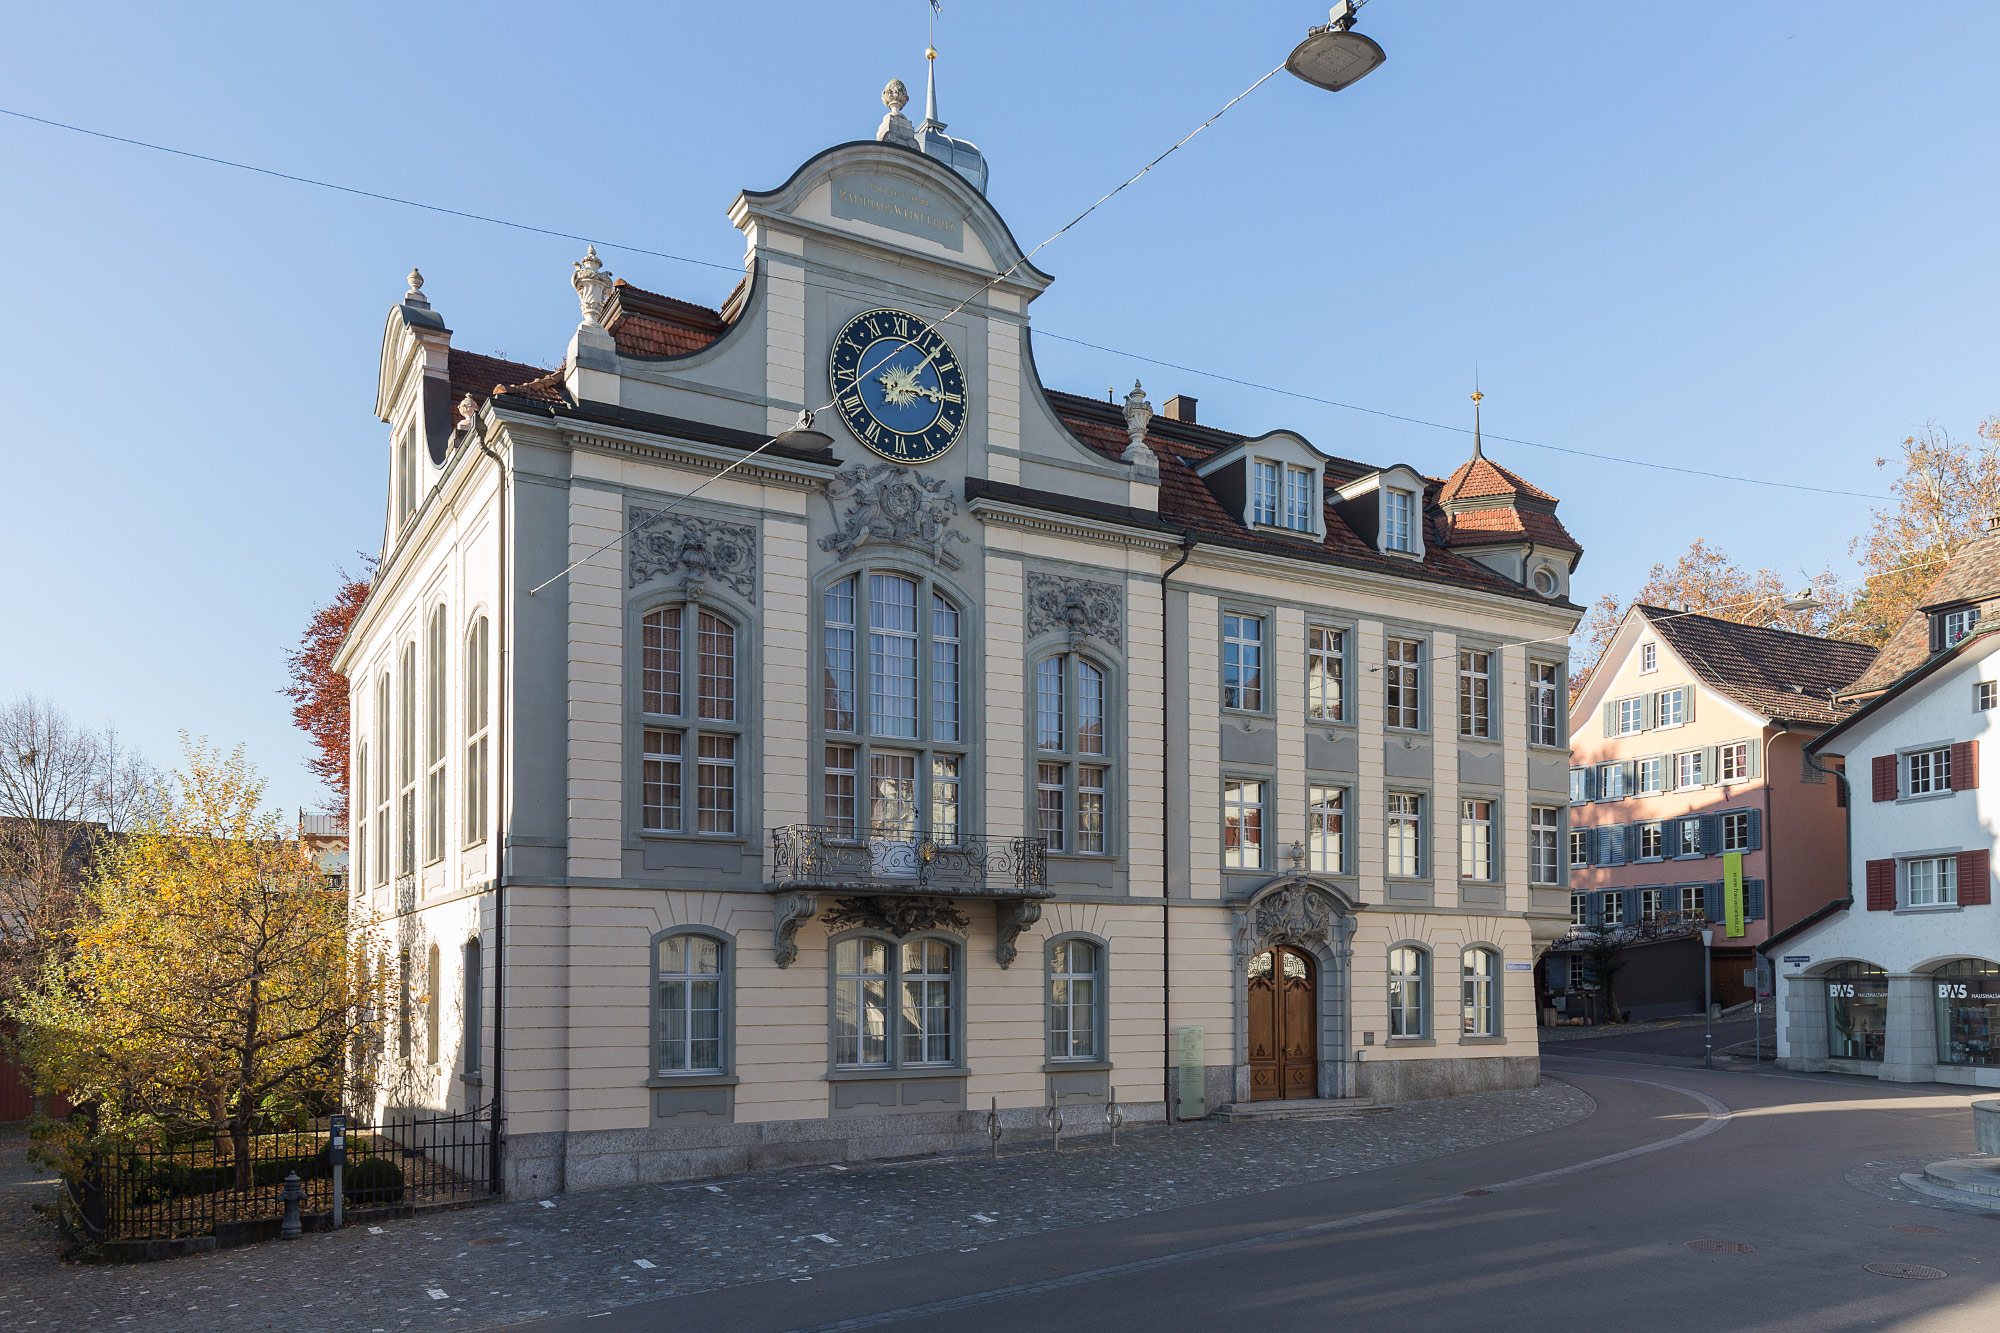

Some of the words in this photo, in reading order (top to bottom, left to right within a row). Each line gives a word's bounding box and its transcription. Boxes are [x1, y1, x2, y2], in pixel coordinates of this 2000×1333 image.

[839, 188, 893, 215] RATHAUS
[864, 318, 882, 339] XI
[892, 317, 909, 337] XII
[844, 336, 863, 354] X
[921, 334, 933, 349] I
[837, 364, 855, 382] IX
[938, 361, 955, 373] II
[843, 394, 864, 417] VIII
[945, 392, 962, 405] III
[864, 420, 881, 444] VII
[937, 415, 956, 436] IIII
[894, 435, 908, 455] VI
[922, 434, 934, 453] V
[1829, 984, 1855, 998] BWS
[1938, 984, 1968, 999] BWS
